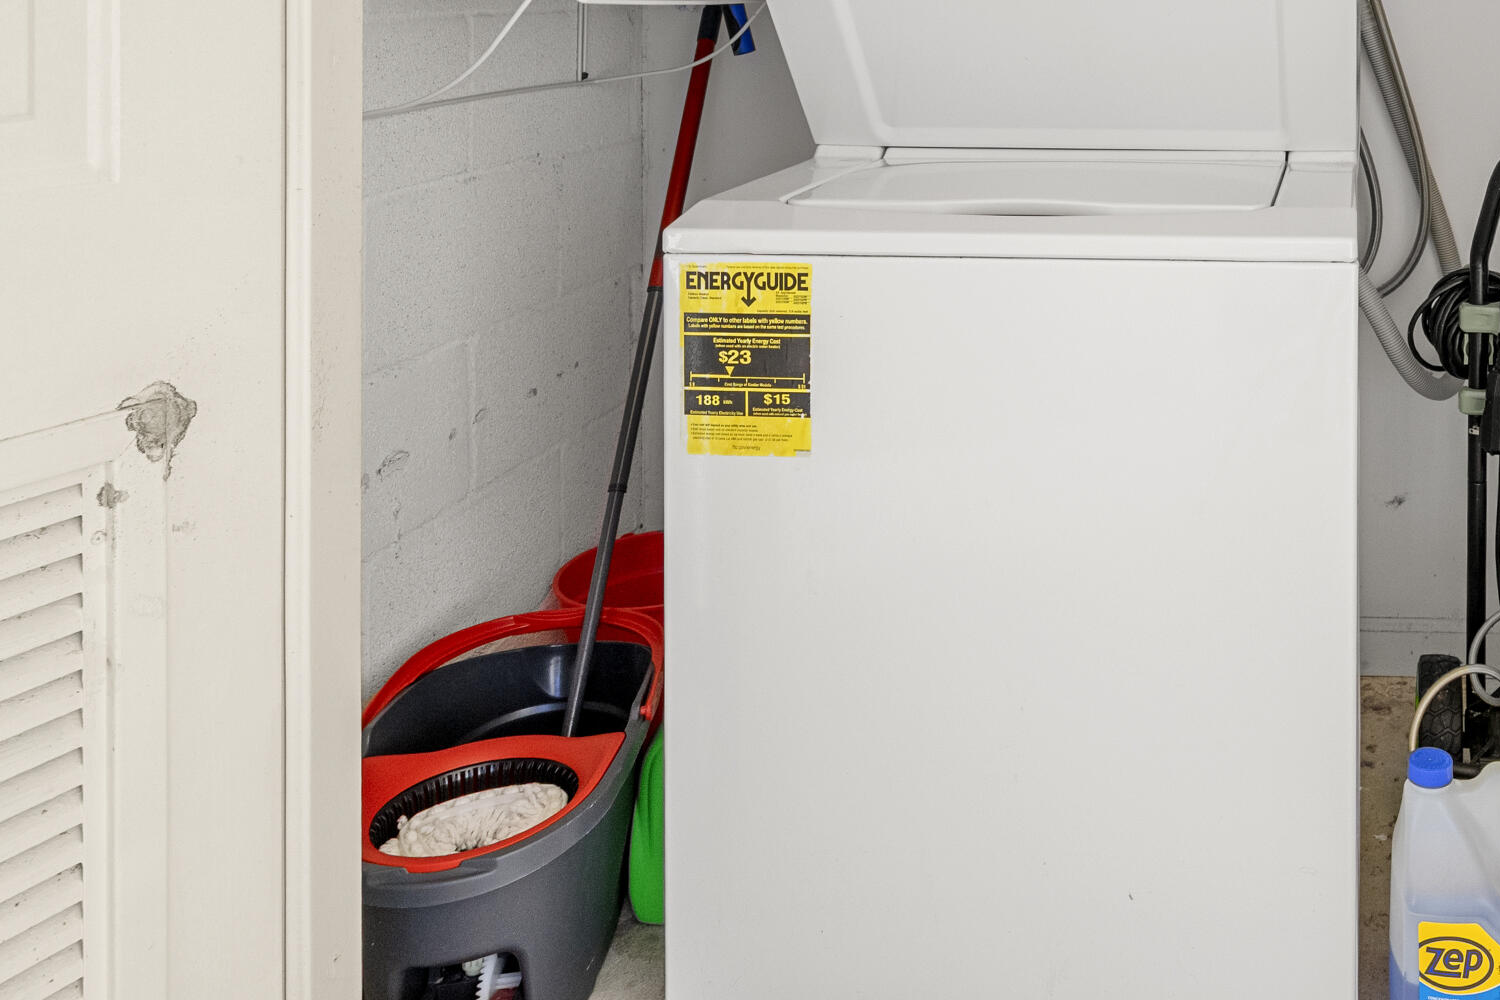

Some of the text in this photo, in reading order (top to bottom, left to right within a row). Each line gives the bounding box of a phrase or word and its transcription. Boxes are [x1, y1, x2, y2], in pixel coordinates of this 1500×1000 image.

[686, 271, 808, 291] ENERGYGUIDE
[719, 350, 752, 364] $23
[696, 395, 720, 406] 188
[763, 394, 790, 405] $15
